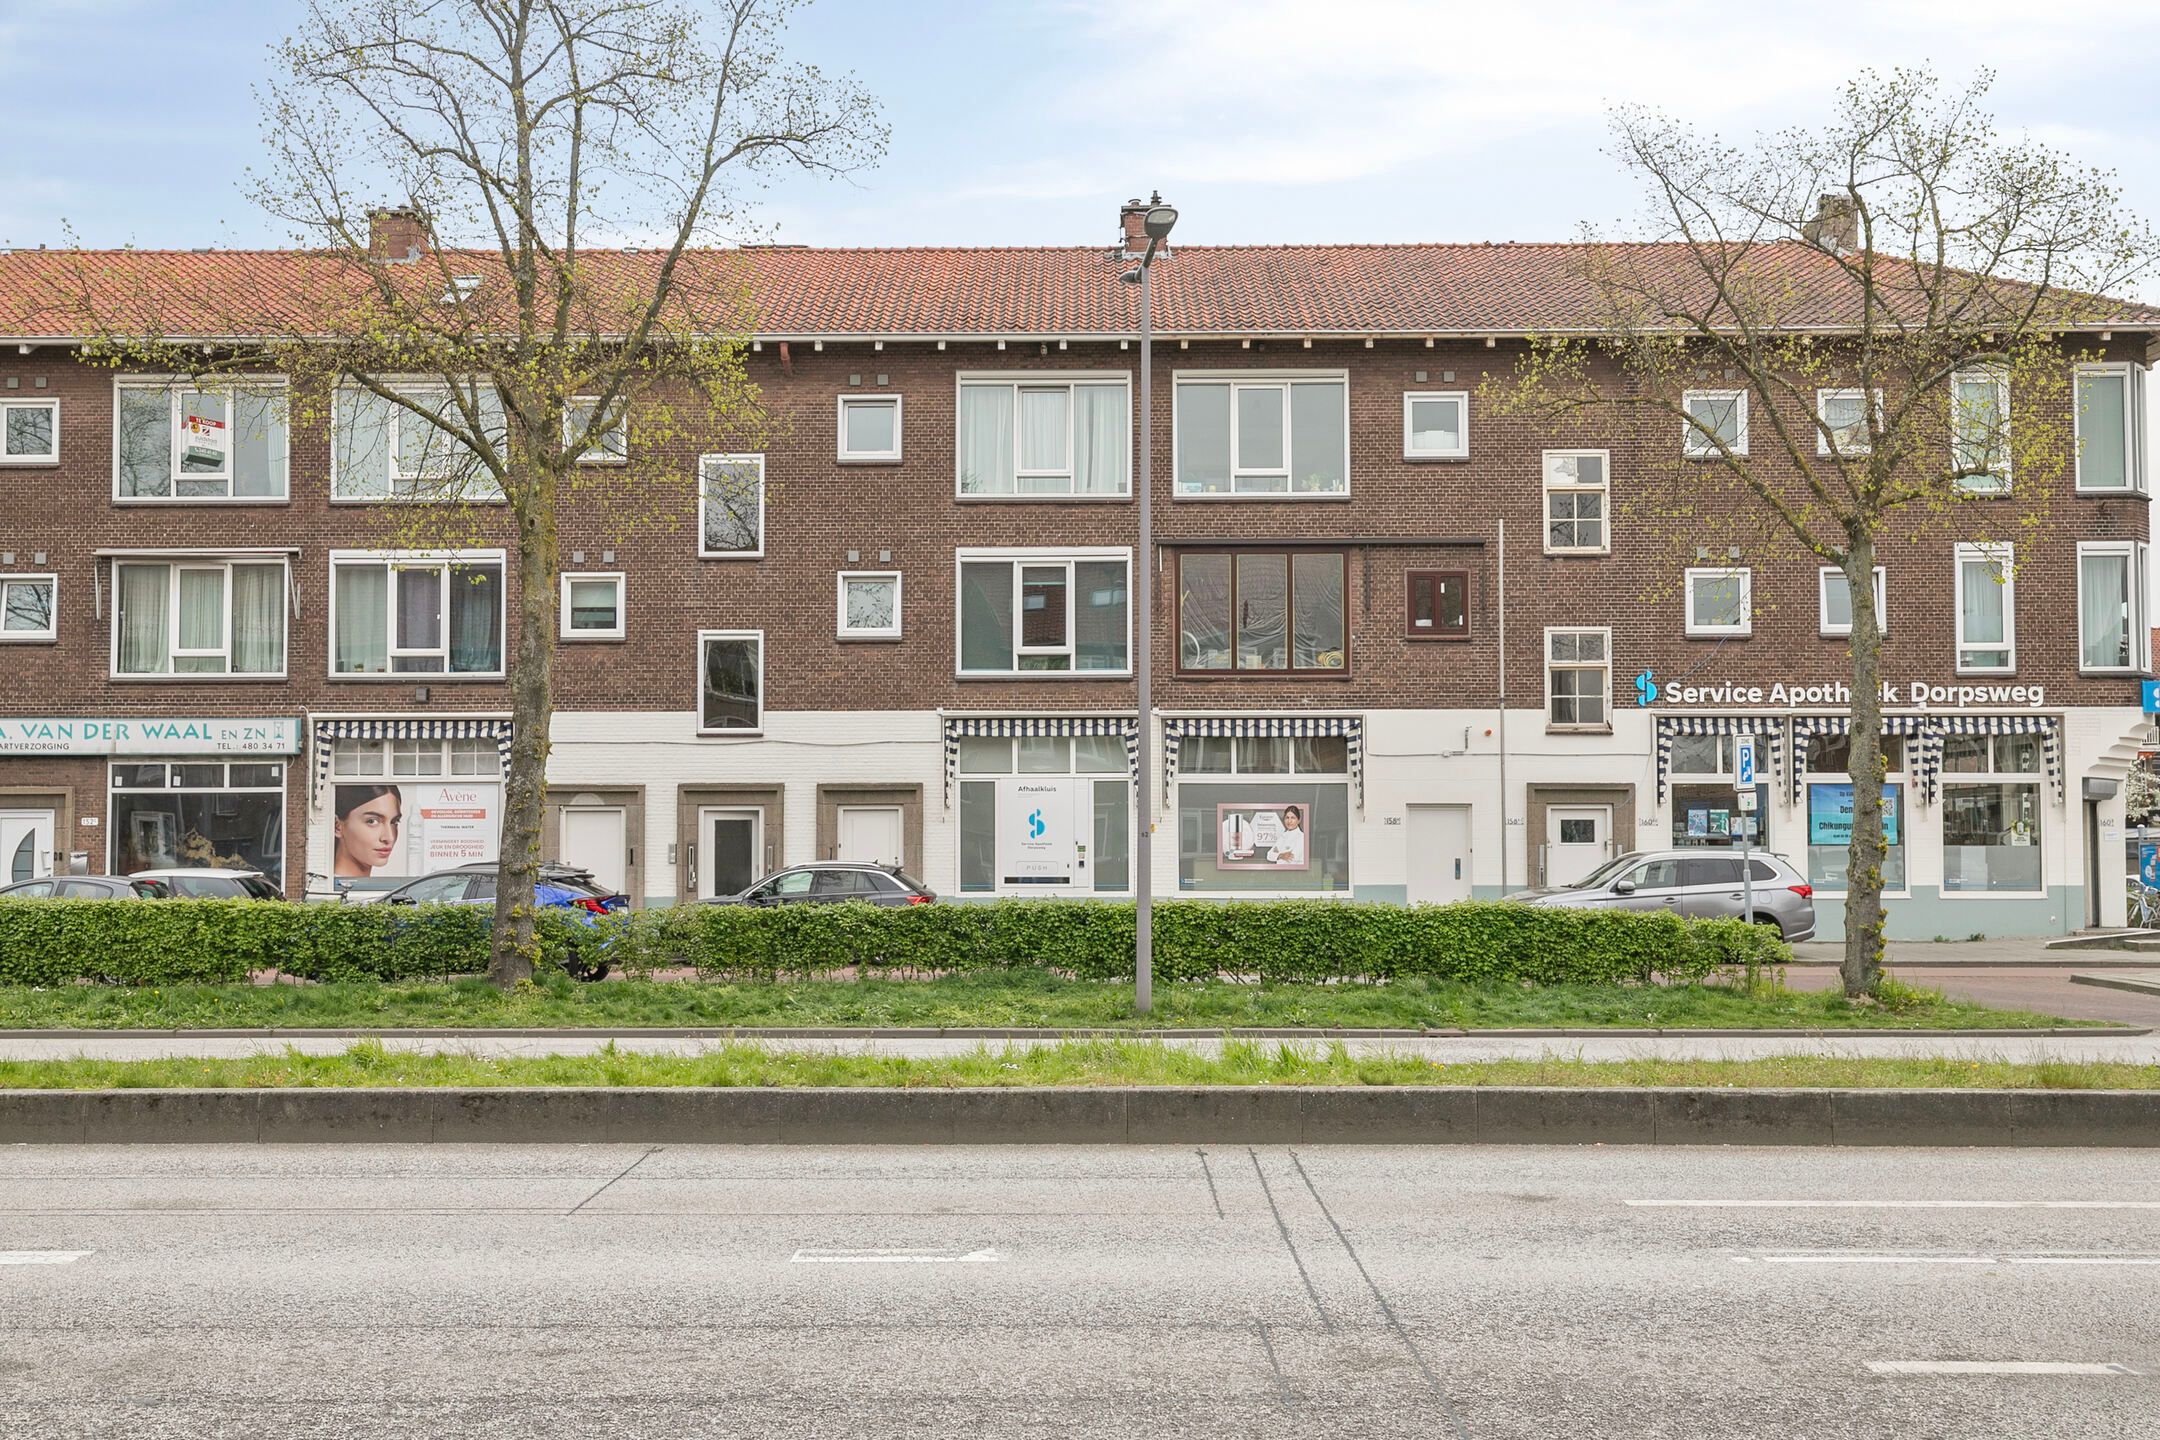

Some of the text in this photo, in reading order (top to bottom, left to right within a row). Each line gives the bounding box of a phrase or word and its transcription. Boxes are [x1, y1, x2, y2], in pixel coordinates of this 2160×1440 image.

[1665, 681, 2044, 708] Service Apothk Dorpsweg
[20, 723, 73, 740] VAN
[84, 723, 130, 740] DER
[141, 723, 213, 740] WAAL
[221, 729, 238, 740] EN
[243, 727, 266, 740] ZN
[242, 742, 259, 750] 480
[262, 742, 273, 750] 34
[276, 742, 286, 750] 71
[439, 787, 477, 802] Avène
[1256, 832, 1278, 841] 97%
[460, 849, 467, 857] 5
